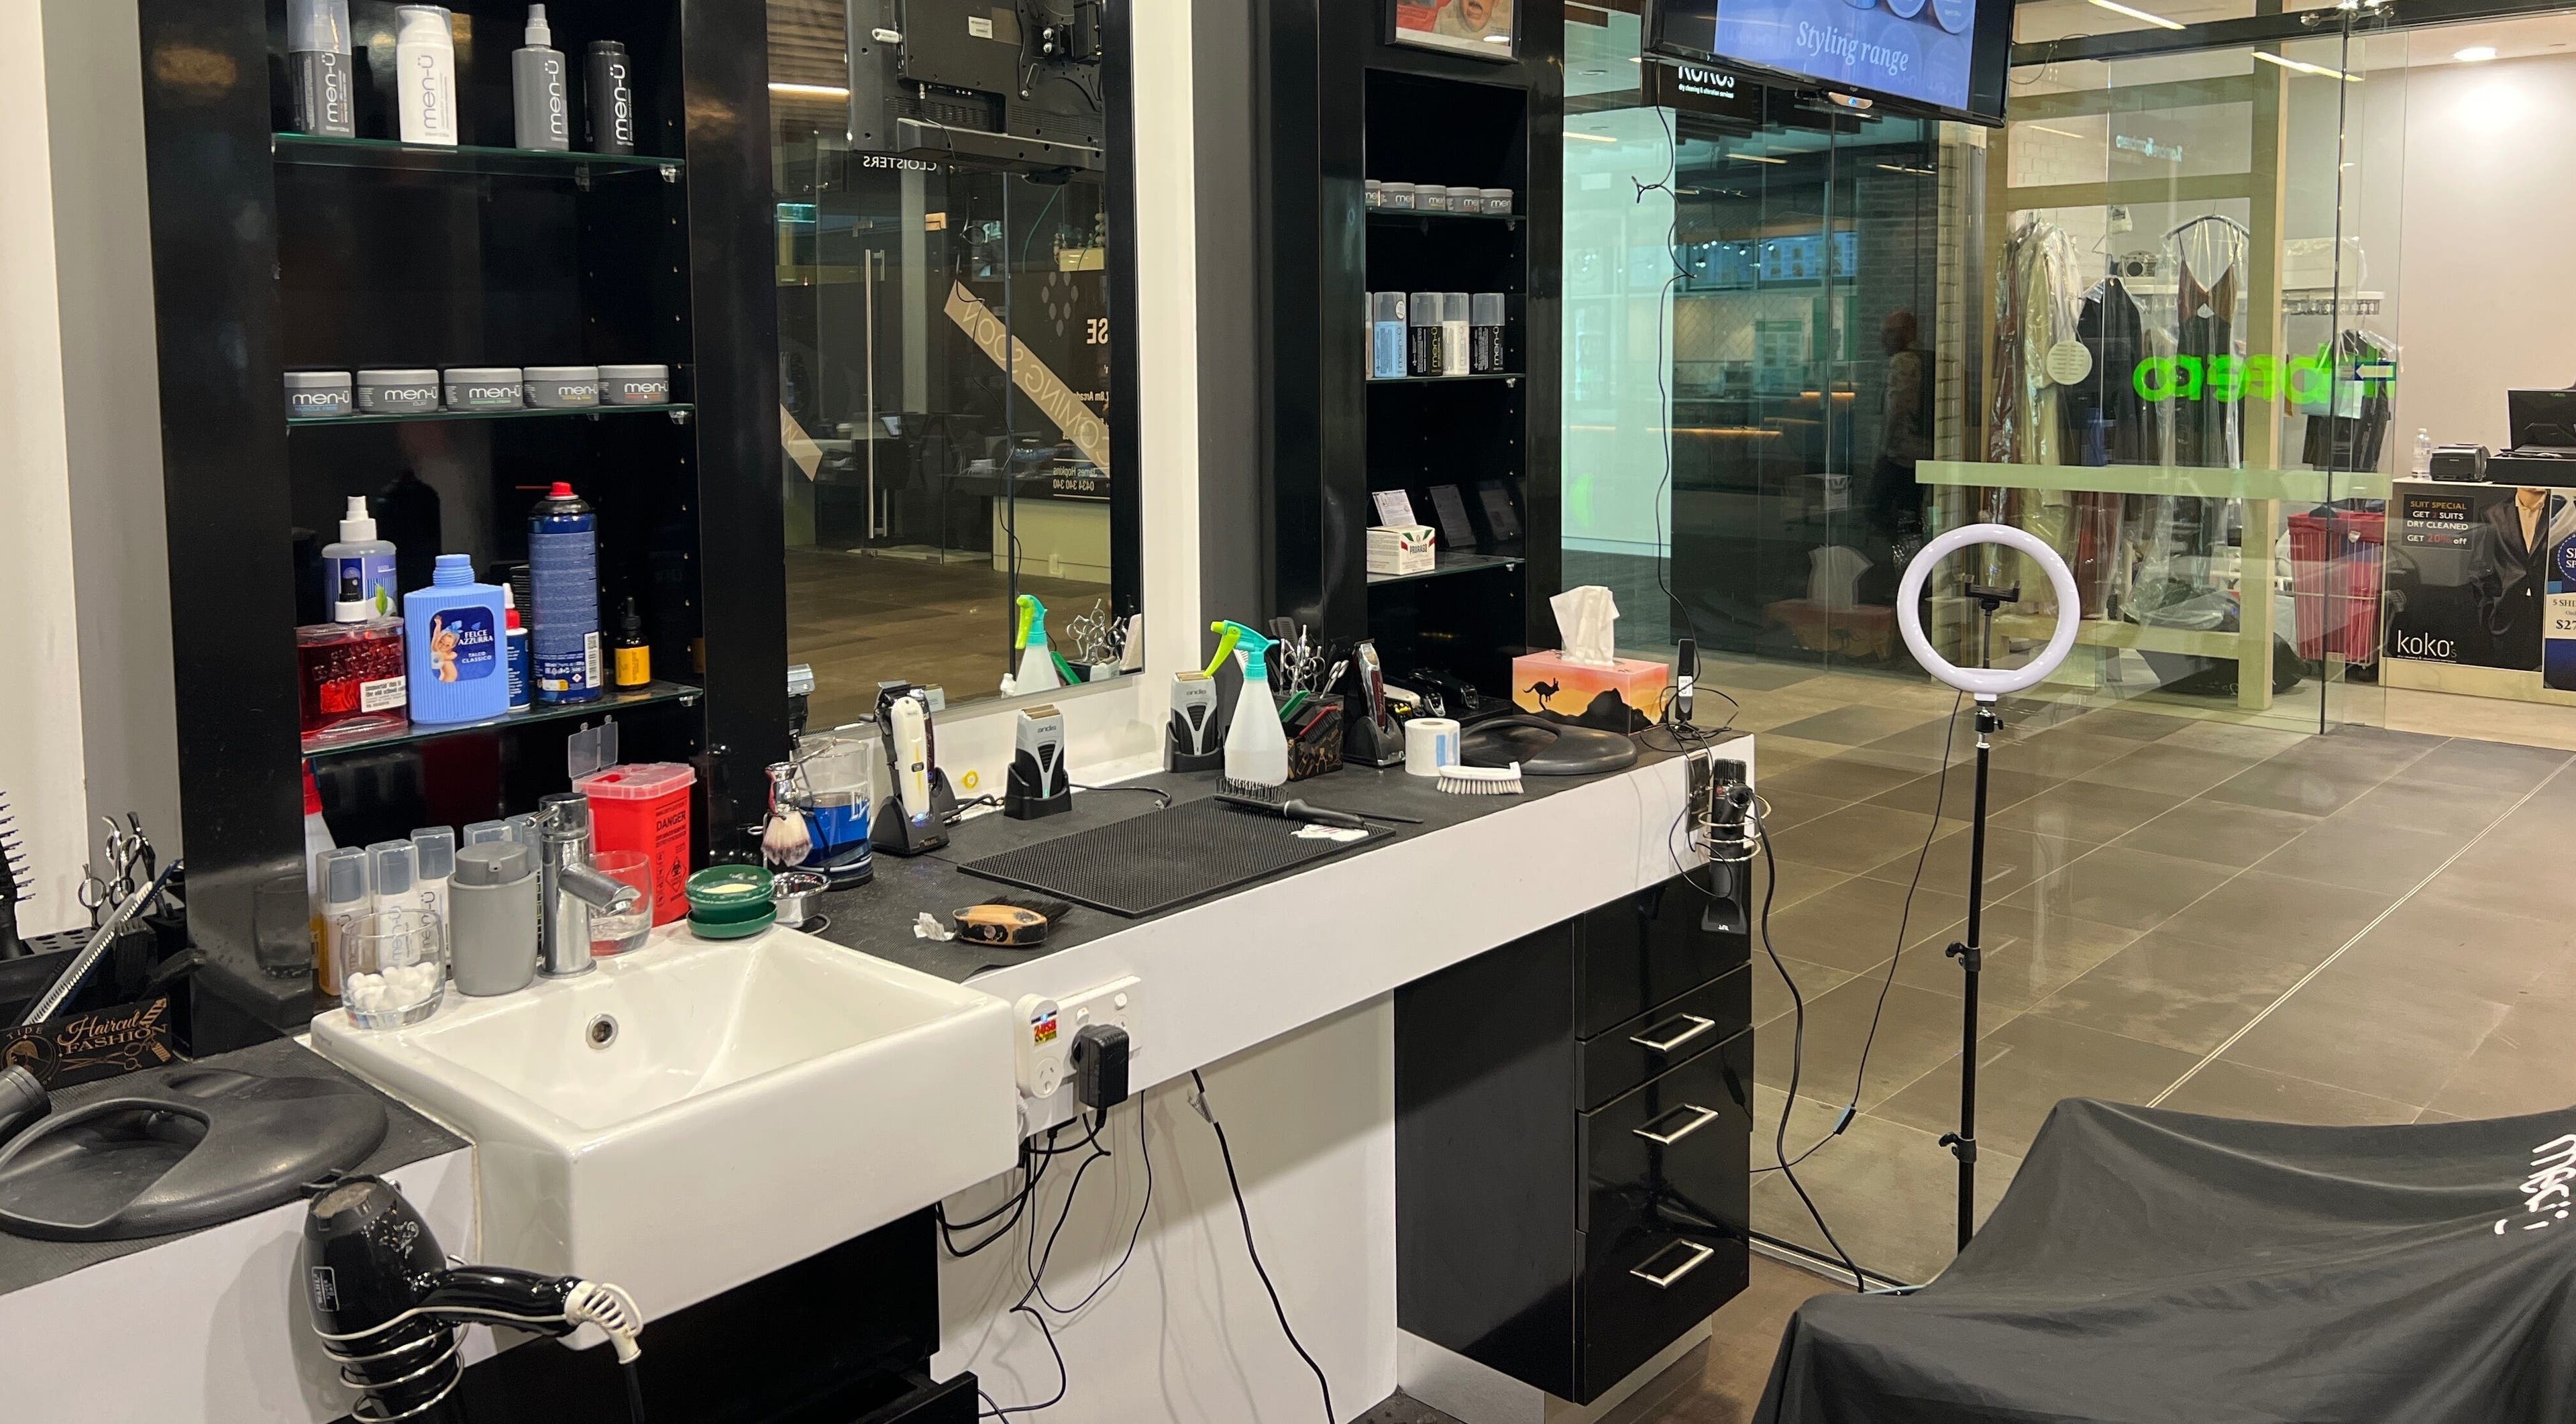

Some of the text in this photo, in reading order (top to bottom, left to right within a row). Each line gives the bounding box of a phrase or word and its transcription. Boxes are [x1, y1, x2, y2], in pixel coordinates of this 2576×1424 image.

[1796, 21, 1909, 76] Styling range
[321, 53, 338, 123] men-ü
[417, 54, 437, 129] men-ü
[545, 60, 562, 134] men-ü
[609, 64, 629, 140] men-ü
[384, 386, 437, 401] men-ü
[469, 384, 521, 398] men-ü
[624, 381, 669, 393] men-ü
[292, 390, 350, 405] men-ü
[2431, 502, 2467, 510] SPECIAL
[2439, 512, 2464, 520] SUITS
[2426, 521, 2469, 530] CLEANED
[458, 635, 494, 645] AZZURRA
[464, 629, 488, 638] FELCE
[462, 655, 492, 663] CLASSICO
[657, 810, 686, 832] DANGER
[66, 1024, 168, 1054] FASHION
